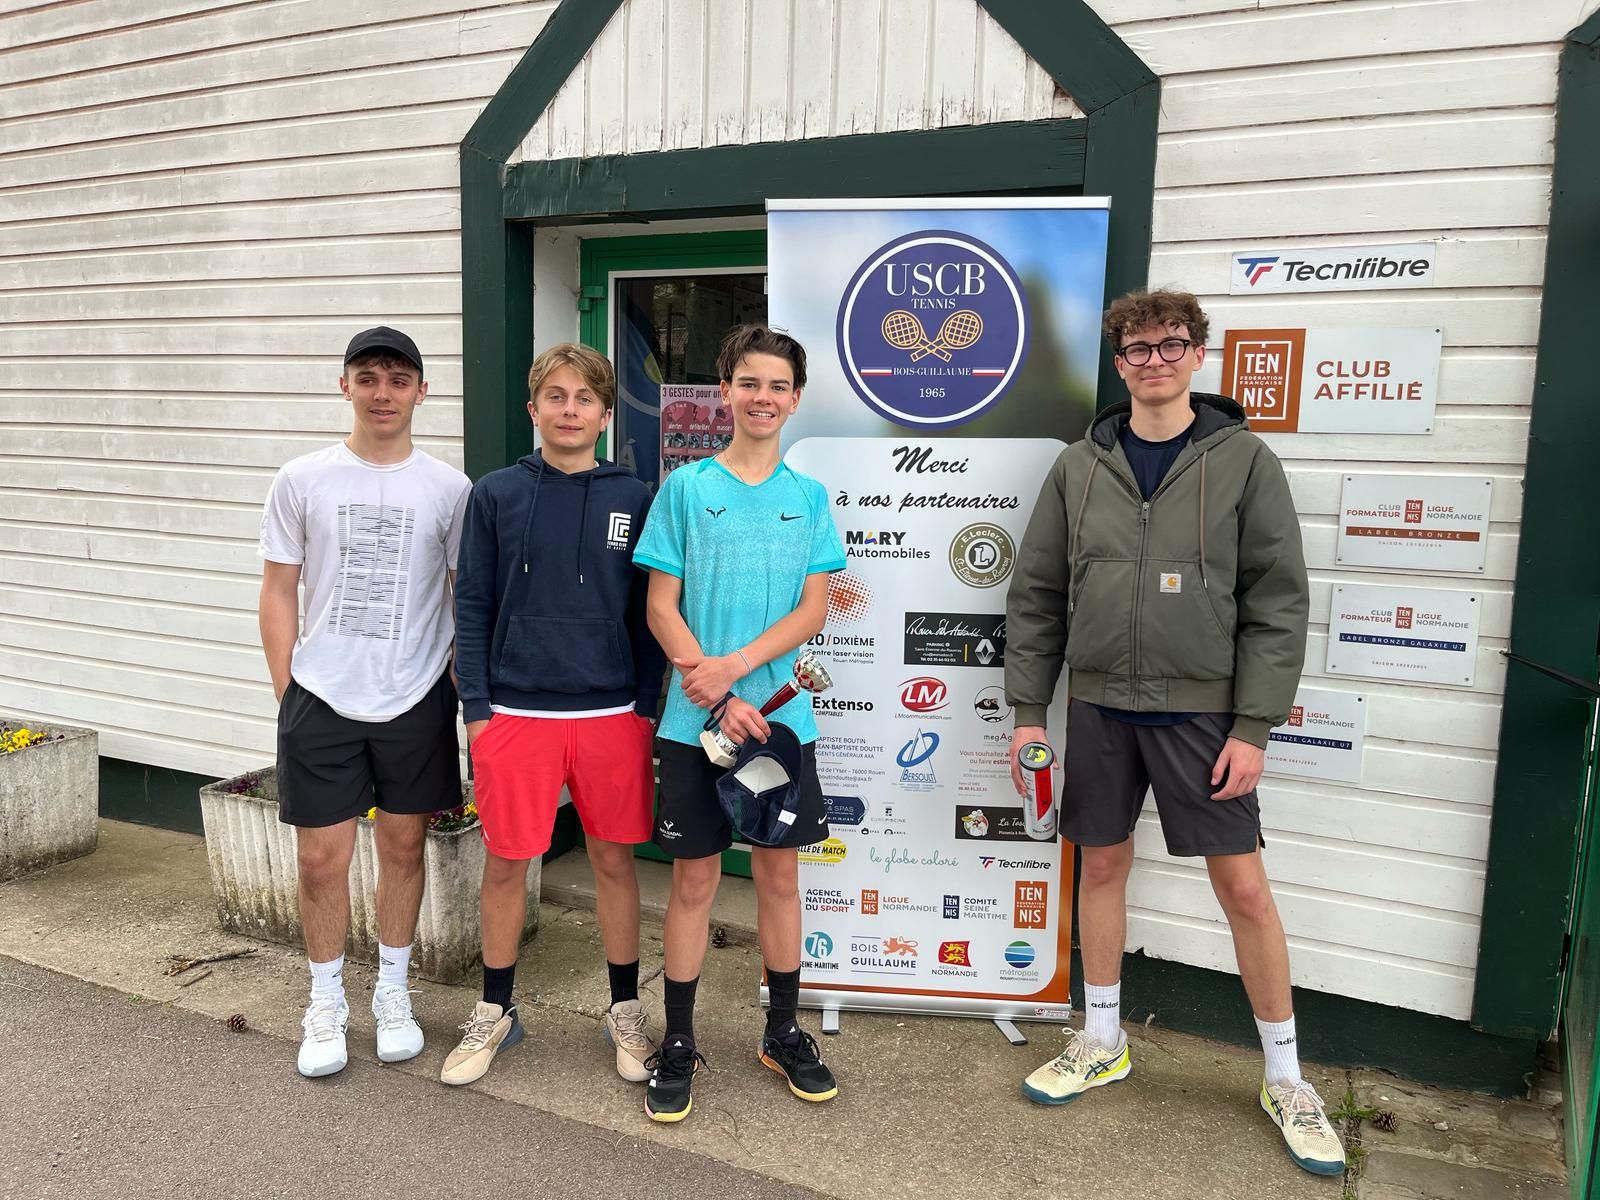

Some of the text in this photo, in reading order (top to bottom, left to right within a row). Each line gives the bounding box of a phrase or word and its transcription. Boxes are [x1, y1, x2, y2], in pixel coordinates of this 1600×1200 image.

[1282, 256, 1430, 282] Tecnifibre
[884, 263, 985, 296] USCB
[911, 298, 956, 309] TENNIS
[1244, 353, 1280, 374] TEN
[1316, 360, 1391, 378] CLUB
[893, 367, 971, 376] BOIS-GUILLAUME
[662, 387, 667, 398] 3
[668, 387, 694, 398] GESTES
[696, 390, 712, 400] pour
[919, 388, 946, 398] 1965
[1313, 381, 1423, 401] AFFILIÉ
[1242, 387, 1276, 408] NIS
[892, 445, 969, 474] Merci
[835, 490, 1021, 512] à nos partenaires
[1346, 509, 1400, 518] FORMATEUR
[1426, 513, 1482, 521] NORMANDIE
[846, 530, 906, 545] MARY
[960, 530, 1004, 544] E.Leclerc
[846, 546, 930, 560] Automobiles
[1340, 614, 1392, 623] FORMATEUR
[1416, 620, 1470, 628] NORMANDIE
[833, 635, 875, 646] DIXIÈME
[904, 685, 944, 704] LM
[813, 696, 874, 711] Extenso
[1306, 718, 1355, 728] NORMANDIE
[1302, 738, 1336, 746] GALAXIE
[822, 847, 846, 855] MATCH
[870, 847, 960, 873] le globe coloré
[998, 859, 1051, 870] Tecnifibre
[806, 889, 842, 897] AGENCE
[1019, 887, 1042, 901] TEN
[805, 896, 855, 906] NATIONALE
[883, 904, 937, 912] NORMANDIE
[964, 912, 1007, 920] MARITIME
[1019, 910, 1041, 923] NIS
[806, 934, 828, 958] 76
[851, 944, 878, 953] BOIS
[800, 961, 839, 970] SEINE-MARITIME
[851, 957, 916, 968] GUILLAUME
[932, 969, 978, 978] NORMANDIE
[1000, 969, 1039, 977] métropole
